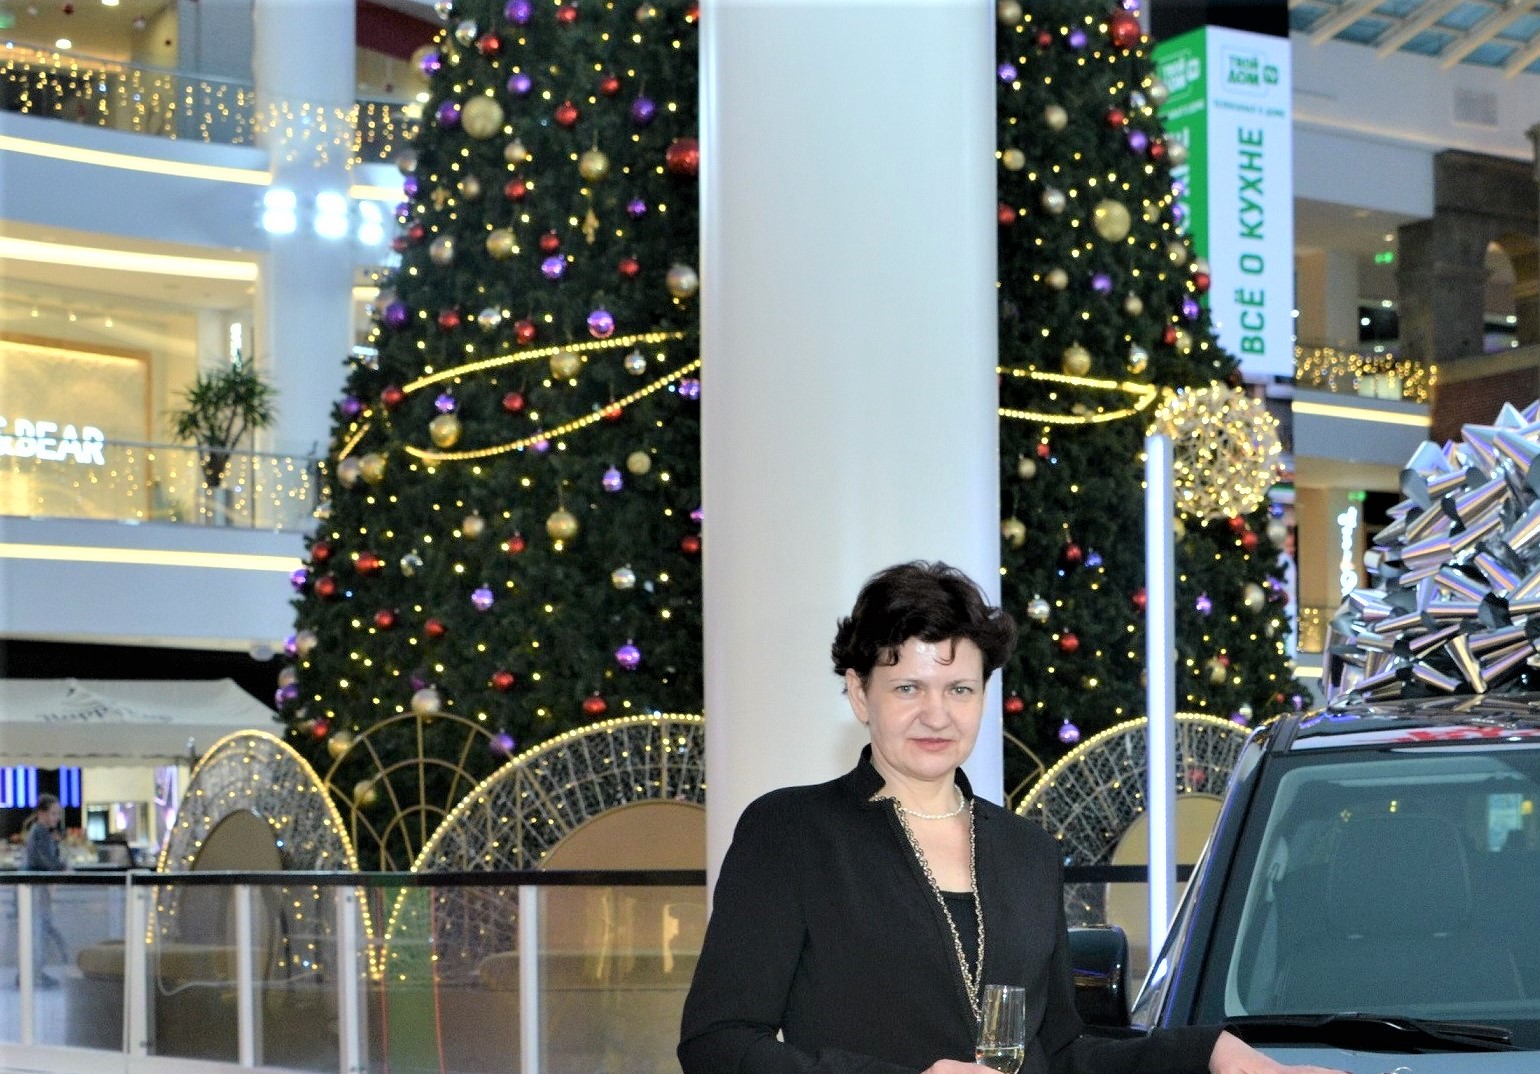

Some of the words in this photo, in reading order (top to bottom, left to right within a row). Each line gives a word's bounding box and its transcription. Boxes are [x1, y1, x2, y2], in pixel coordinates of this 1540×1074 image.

[1238, 127, 1264, 240] КУХНЕ
[1239, 253, 1265, 275] О
[1235, 288, 1266, 355] ВСЁ
